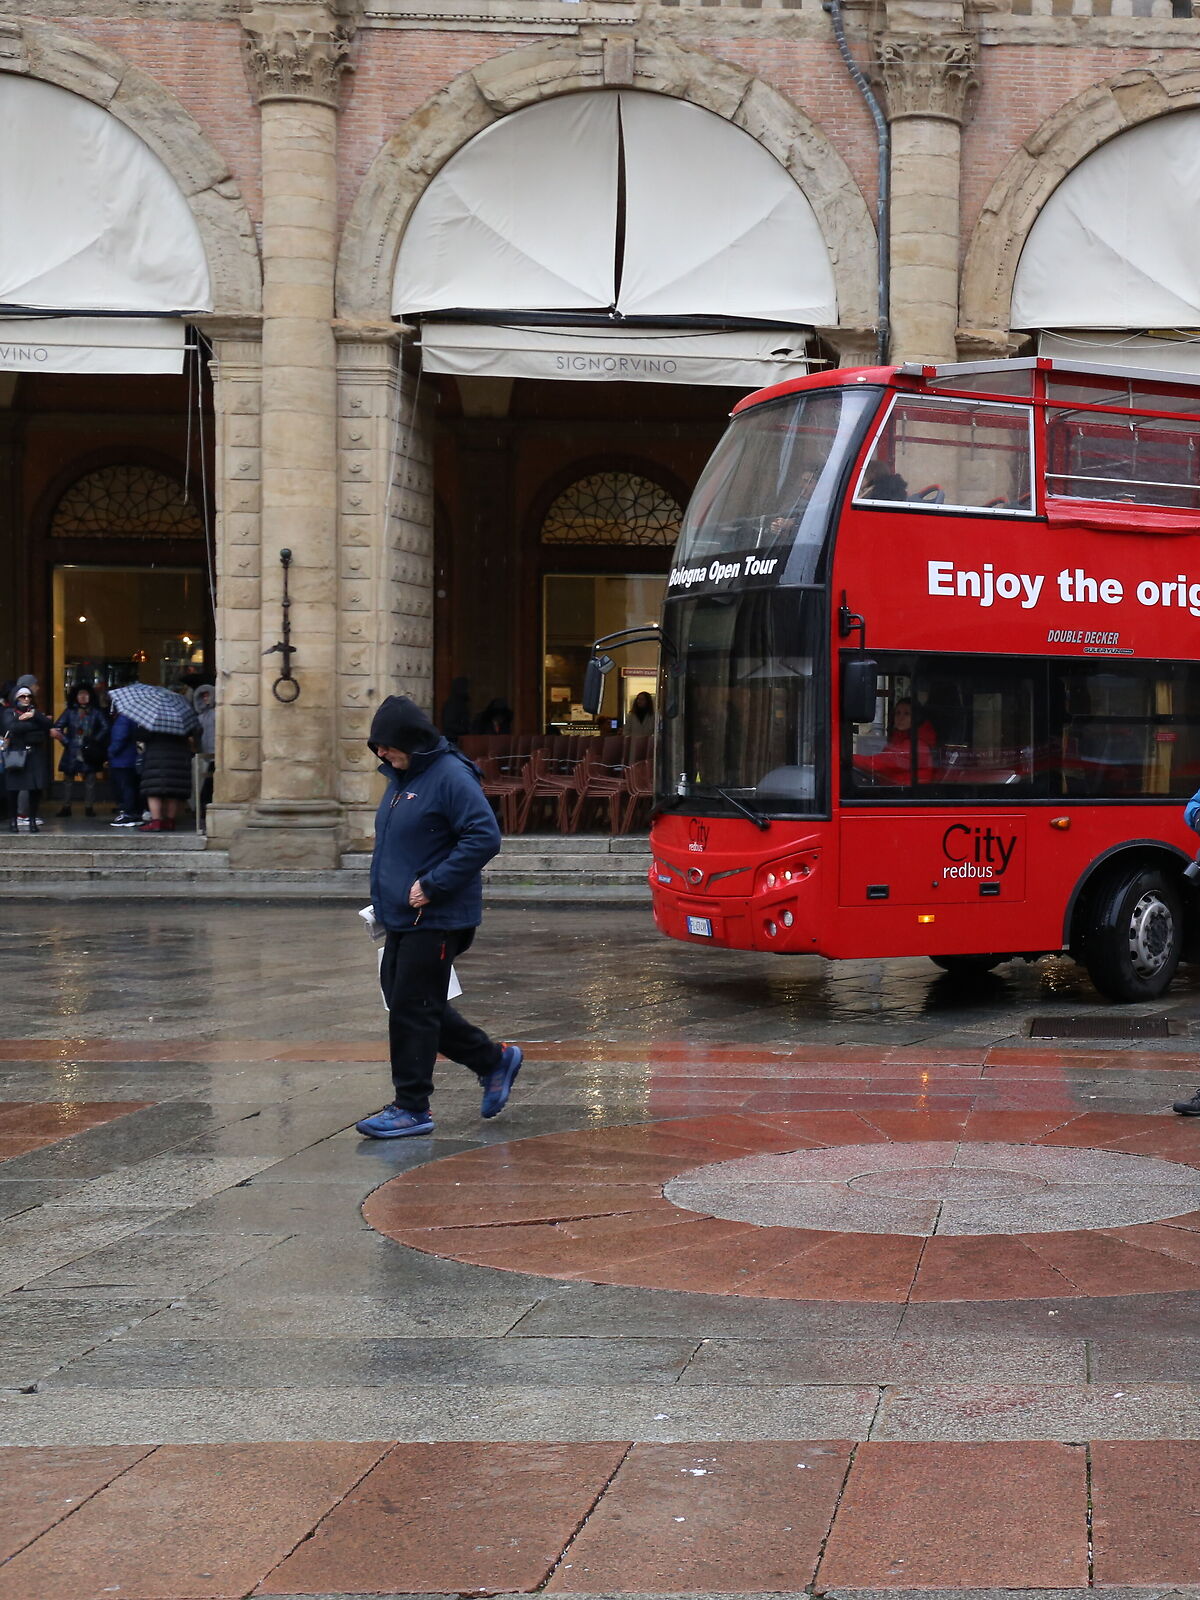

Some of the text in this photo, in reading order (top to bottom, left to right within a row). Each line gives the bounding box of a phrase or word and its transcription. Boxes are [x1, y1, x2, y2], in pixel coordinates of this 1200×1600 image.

[556, 355, 677, 374] SIGNORVINO
[668, 555, 778, 588] Bologna Open Tour
[927, 560, 1045, 609] Enjoy
[1057, 568, 1125, 604] the
[1047, 629, 1119, 645] DOUBLE DECKER
[688, 818, 710, 851] City
[942, 823, 1018, 876] City
[943, 862, 993, 879] redbus
